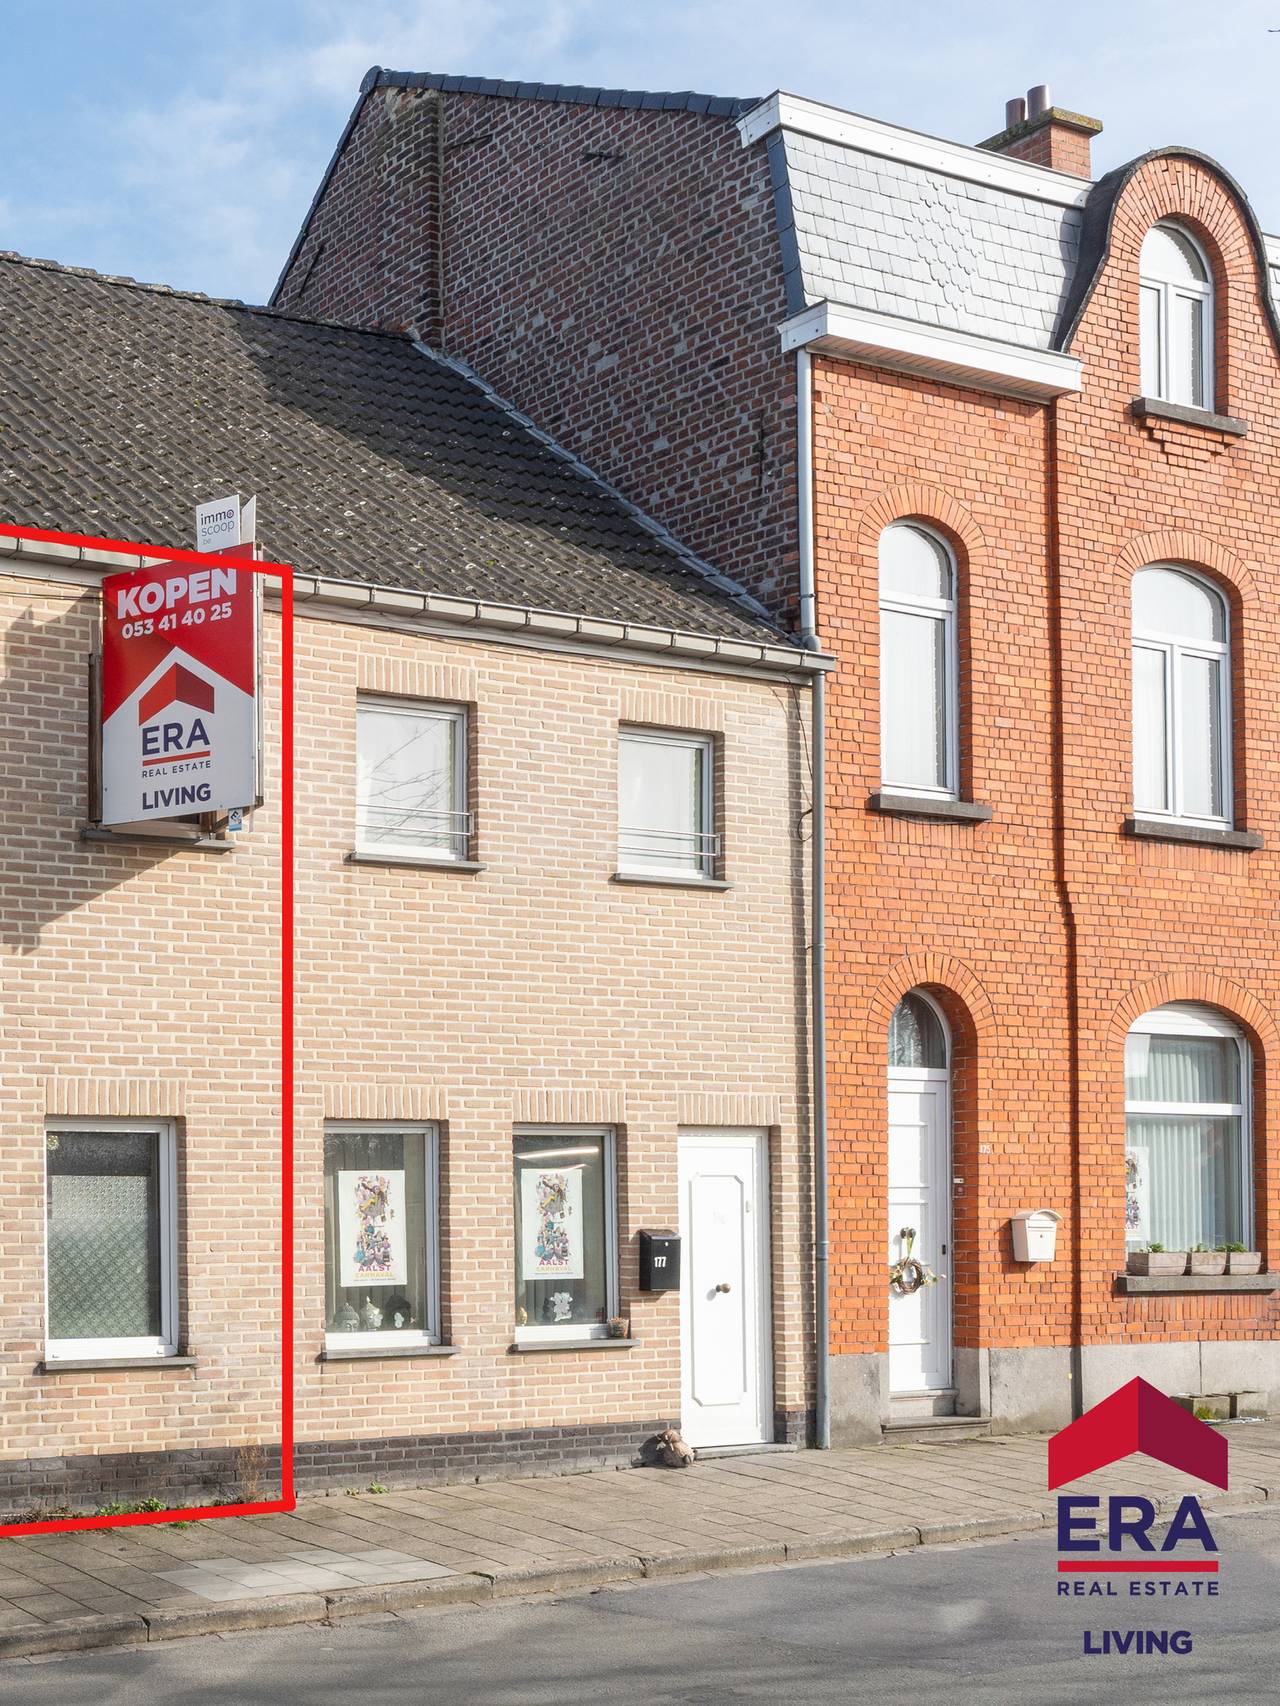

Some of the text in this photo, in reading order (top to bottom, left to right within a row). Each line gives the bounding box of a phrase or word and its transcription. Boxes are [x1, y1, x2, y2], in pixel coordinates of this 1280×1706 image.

[200, 509, 234, 525] immo
[201, 520, 234, 537] scoop
[117, 567, 237, 620] KOPEN
[121, 602, 232, 639] 053 41 40 25
[142, 718, 211, 756] ERA
[142, 760, 211, 778] REAL ESTATE
[142, 783, 211, 810] LIVING
[358, 1264, 391, 1272] AALST
[654, 1256, 667, 1268] 177
